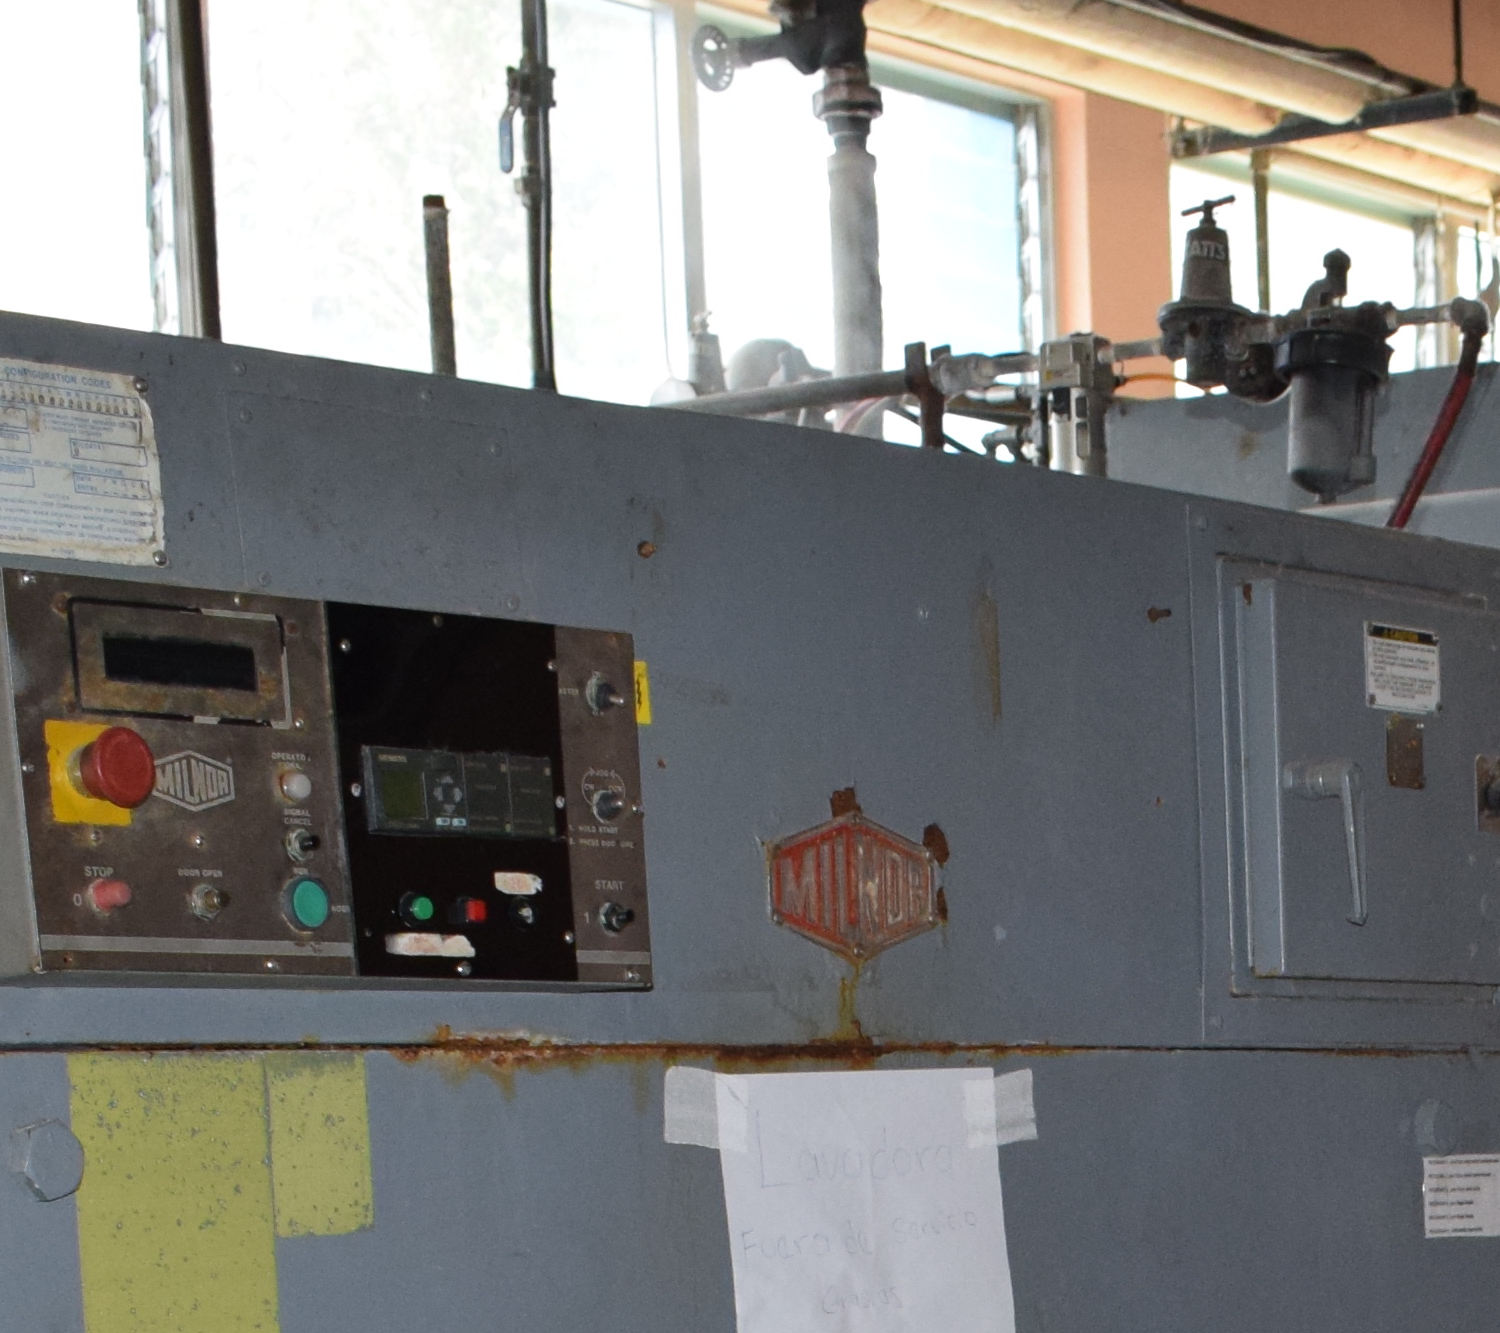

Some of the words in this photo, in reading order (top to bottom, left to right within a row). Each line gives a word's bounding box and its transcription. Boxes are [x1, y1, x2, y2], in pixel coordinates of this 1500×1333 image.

[1188, 239, 1226, 260] ATTS
[4, 366, 77, 384] CONFIGURATION
[81, 377, 112, 389] CODES
[156, 757, 228, 804] MILNOR
[283, 817, 312, 826] CANCEL
[84, 867, 114, 877] STOP
[178, 869, 201, 877] DOOR
[202, 869, 223, 878] OPEN
[595, 880, 624, 891] START
[779, 831, 923, 940] MILNOR
[756, 1110, 952, 1188] Lavadora
[741, 1231, 831, 1261] Fuera
[844, 1219, 872, 1255] de
